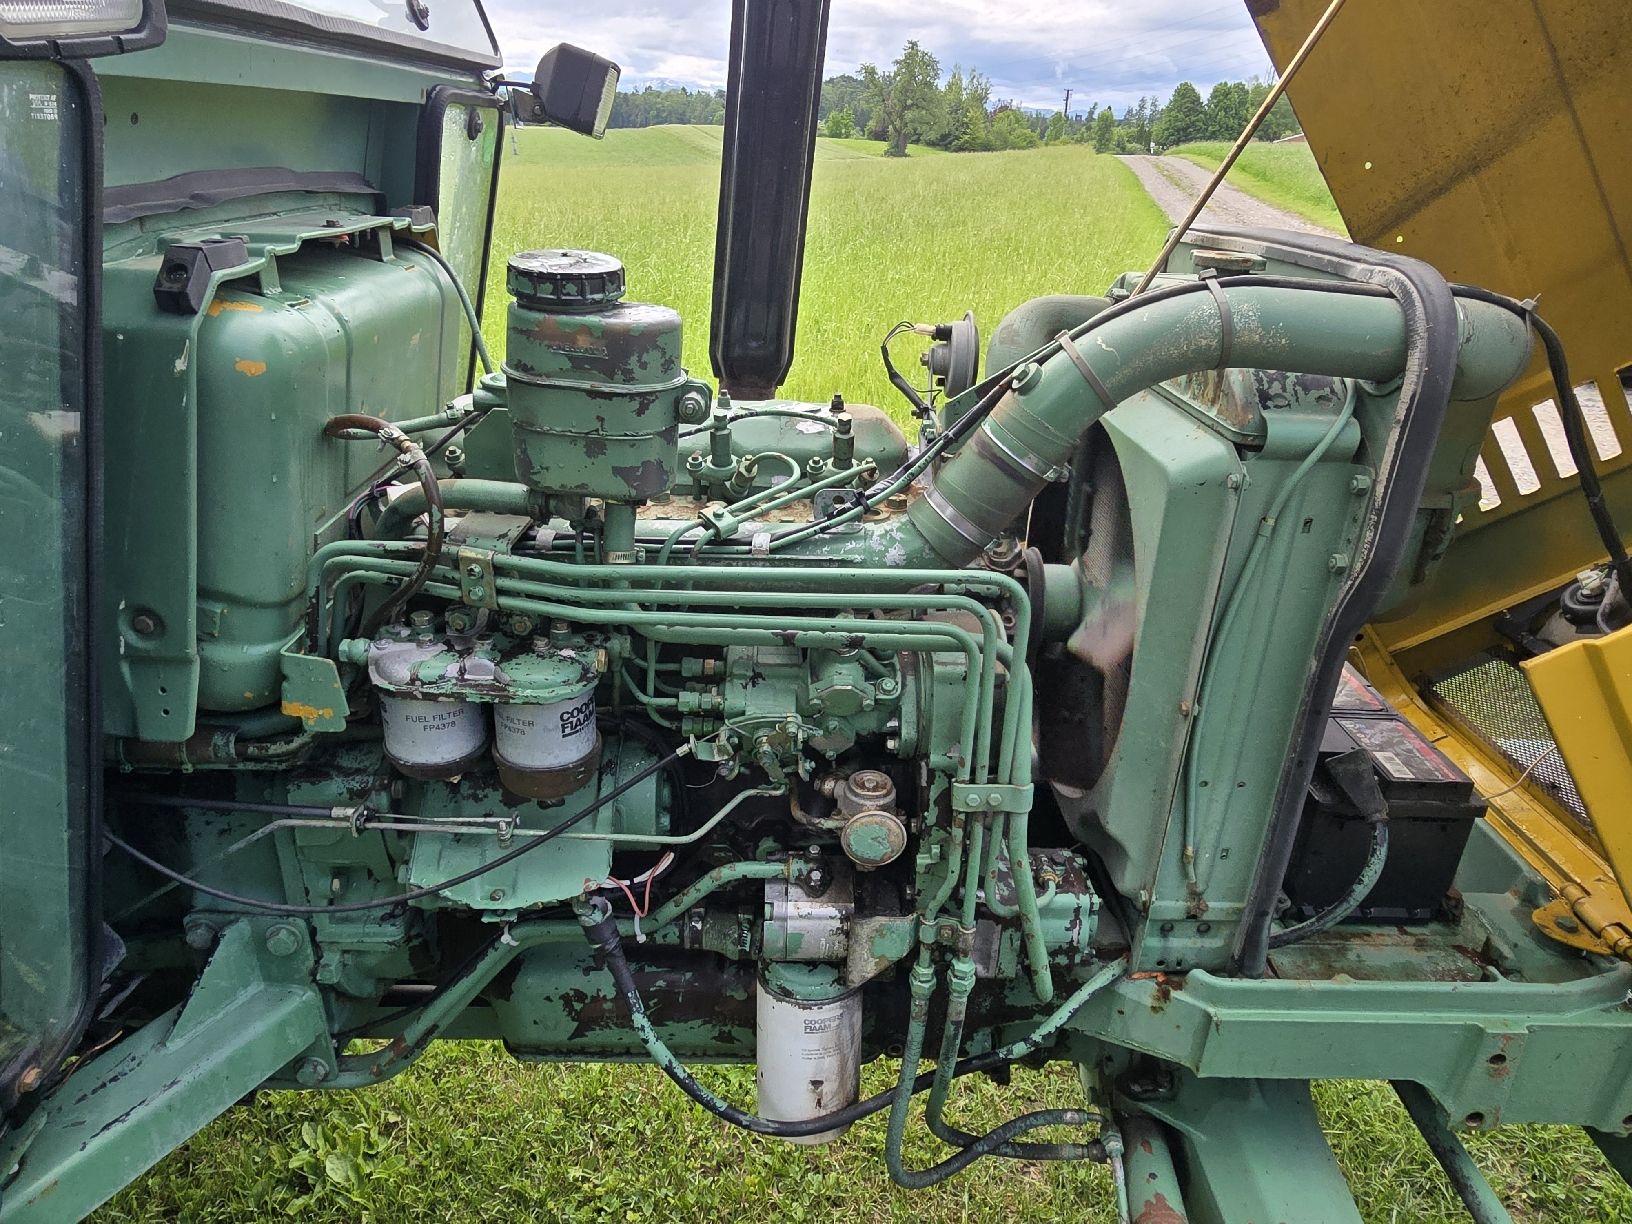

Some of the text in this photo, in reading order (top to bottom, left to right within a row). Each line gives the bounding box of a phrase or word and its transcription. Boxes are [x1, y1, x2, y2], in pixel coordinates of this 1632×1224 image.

[405, 708, 464, 723] FUEL FILTER
[423, 720, 456, 732] FP4378
